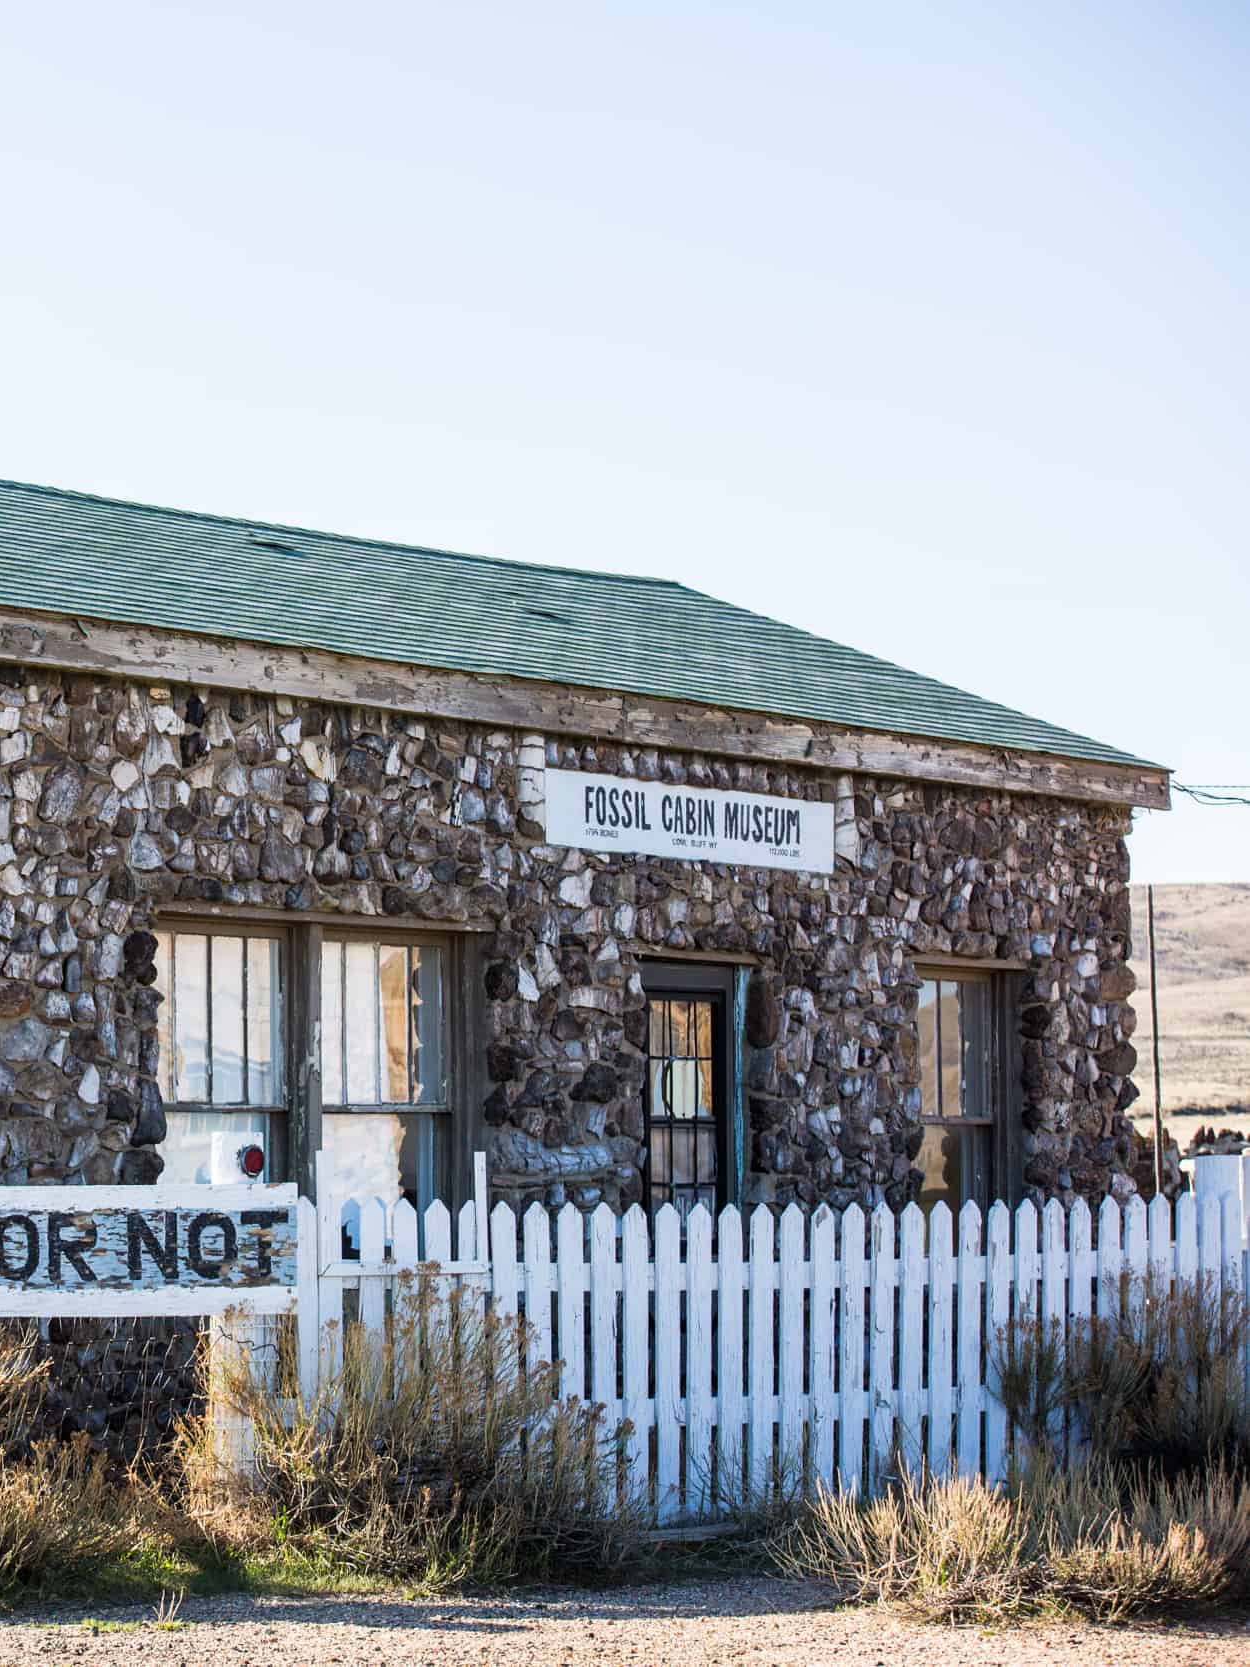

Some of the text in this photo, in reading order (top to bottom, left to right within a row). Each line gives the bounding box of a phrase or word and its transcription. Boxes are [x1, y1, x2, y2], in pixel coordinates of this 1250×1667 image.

[585, 785, 800, 846] FOSSIL CABIN MUSEUM
[127, 1211, 289, 1280] NOT
